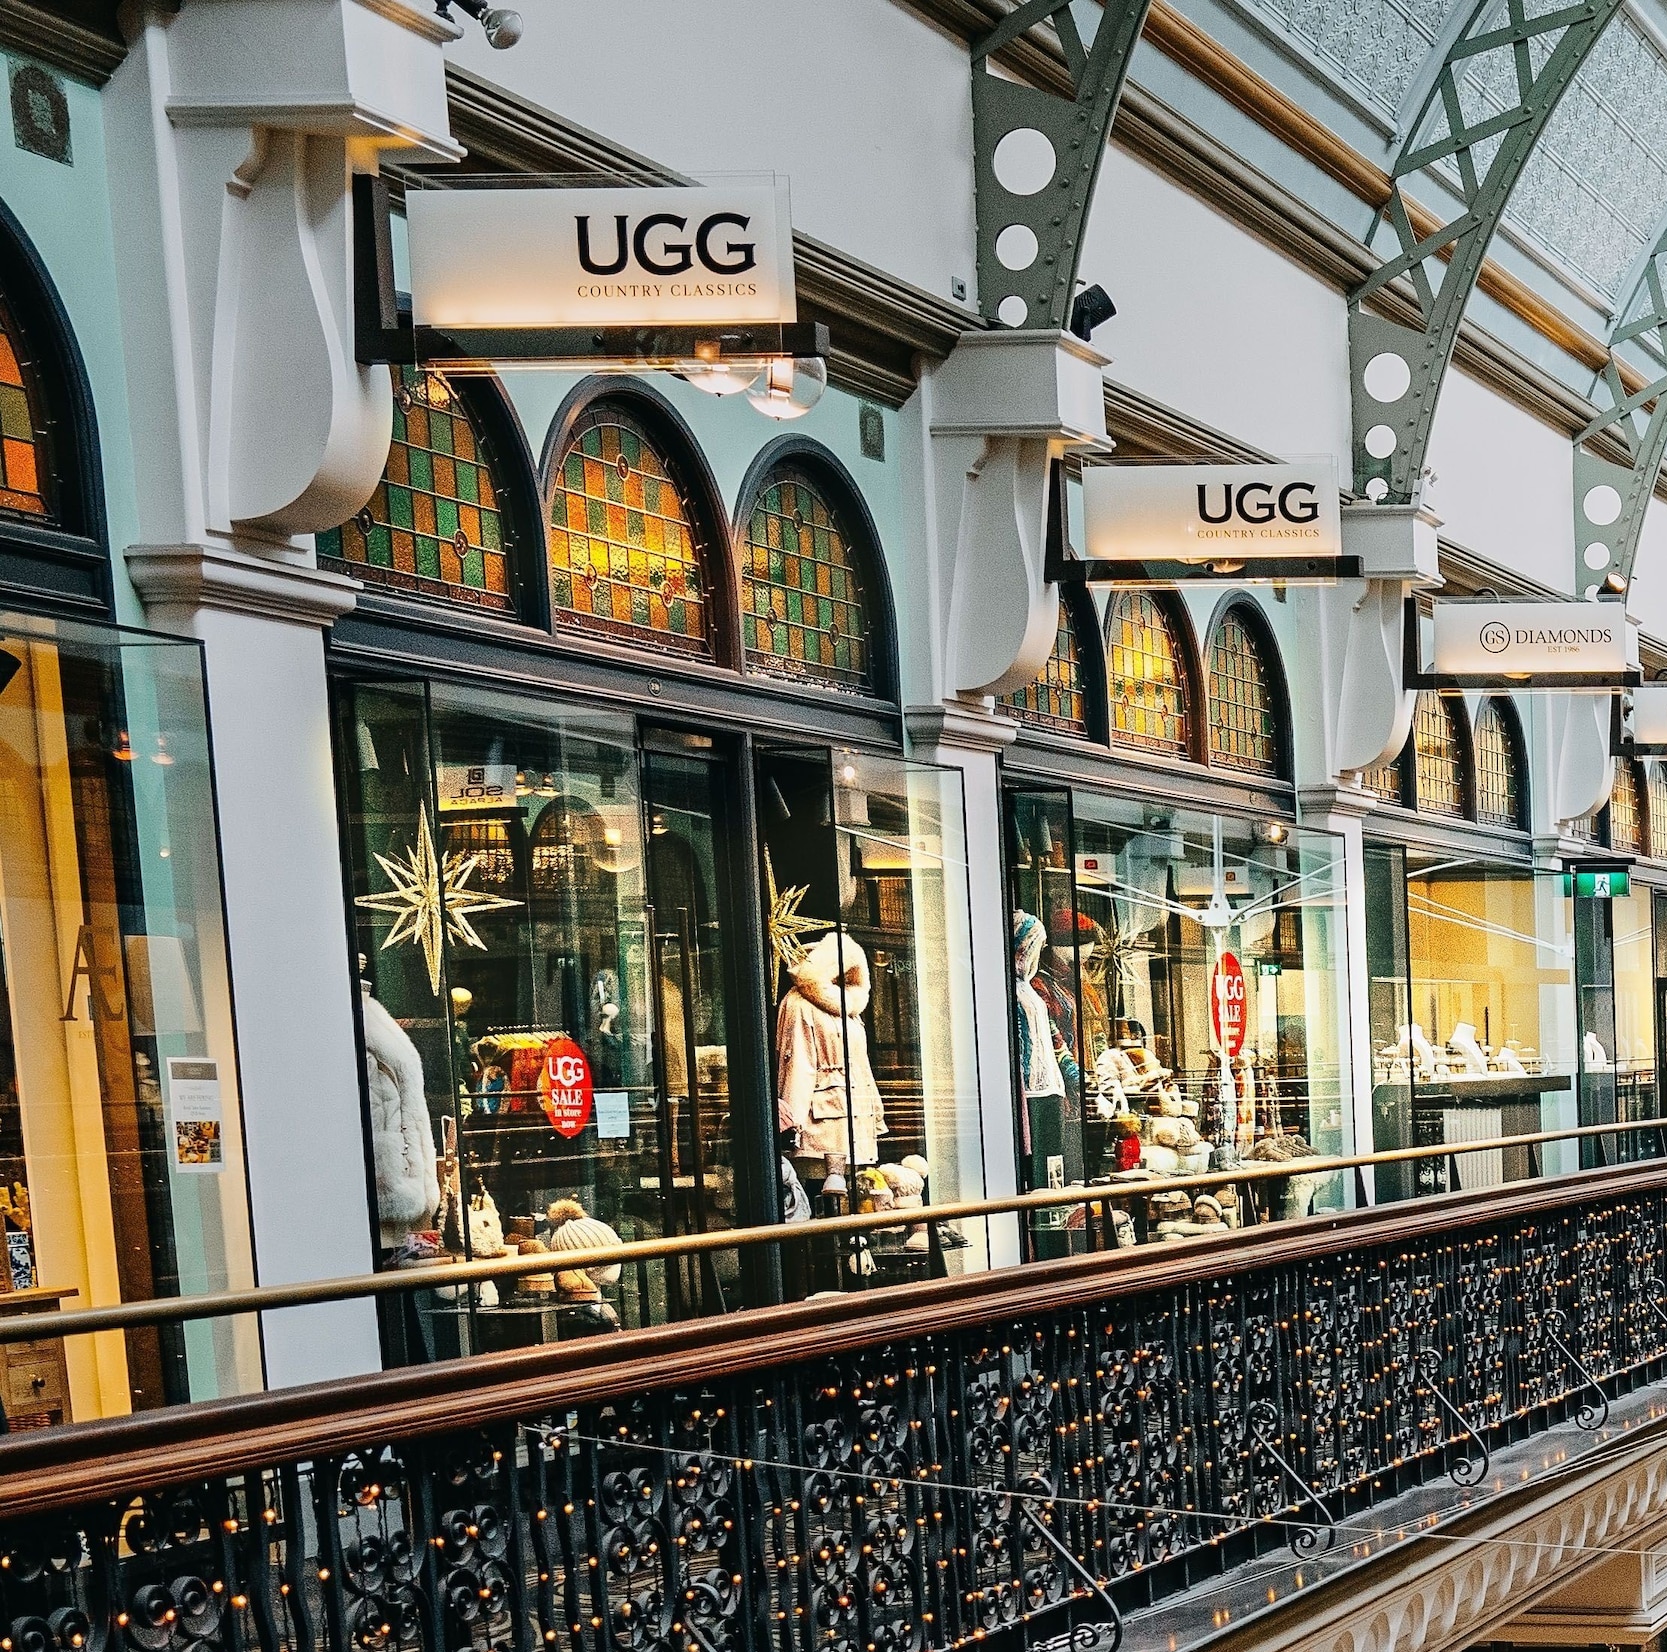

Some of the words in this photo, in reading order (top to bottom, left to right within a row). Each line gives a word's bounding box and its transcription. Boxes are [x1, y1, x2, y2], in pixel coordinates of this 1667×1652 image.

[574, 212, 757, 275] UGG
[577, 284, 663, 298] COUNTRY
[670, 283, 757, 297] CLASSICS
[1196, 482, 1320, 524] UGG
[1197, 529, 1256, 539] COUNTRY
[1260, 528, 1320, 538] CLASSICS
[1484, 629, 1505, 645] GS
[1515, 628, 1612, 644] DIAMONDS
[548, 1056, 584, 1087] UGG
[551, 1089, 583, 1106] SALE
[554, 1107, 562, 1117] in
[563, 1108, 582, 1117] store
